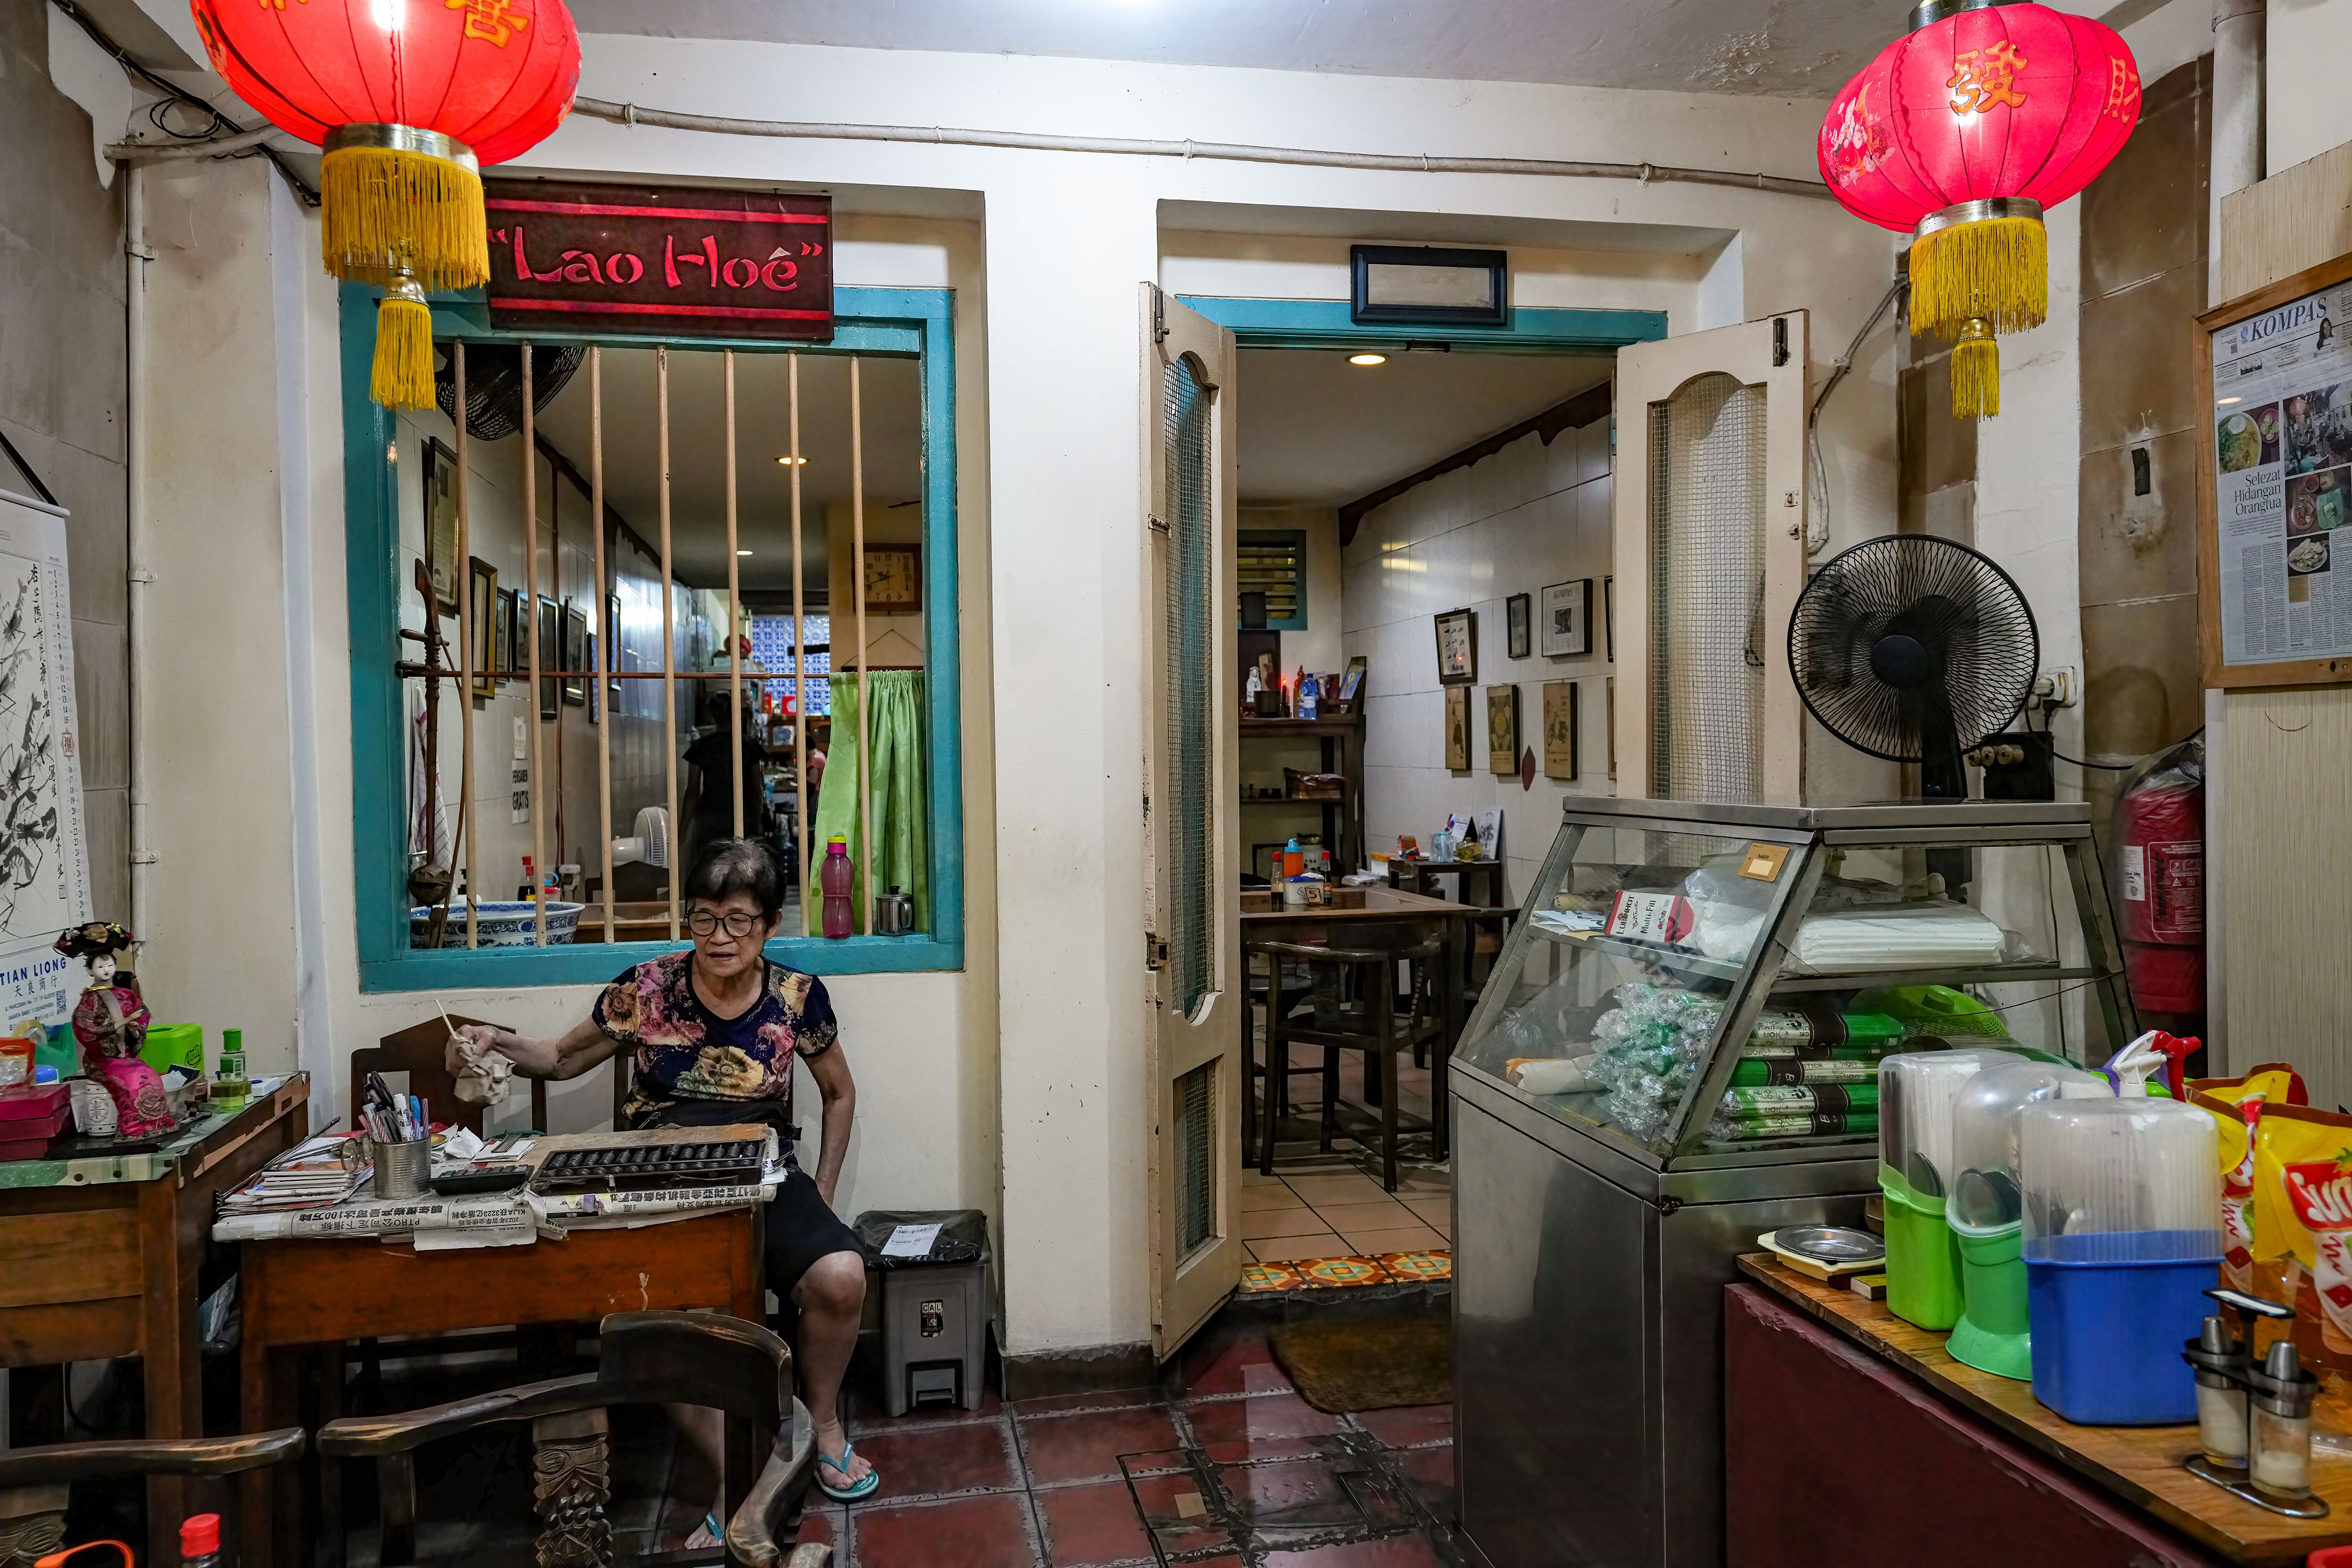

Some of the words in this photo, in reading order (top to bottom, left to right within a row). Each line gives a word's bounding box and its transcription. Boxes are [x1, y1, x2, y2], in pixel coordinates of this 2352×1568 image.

[2250, 297, 2327, 342] KOMPAS
[2245, 469, 2281, 487] Selezat
[2234, 483, 2281, 503] Hidangan
[2236, 498, 2281, 516] Orangtua
[512, 790, 529, 811] GRATIS
[1641, 900, 1656, 934] Multi-Fill
[0, 967, 28, 986] TIAN
[34, 957, 66, 977] LIONG
[15, 975, 57, 997] 天良商行
[321, 1216, 421, 1232] PTRO公司定下指标
